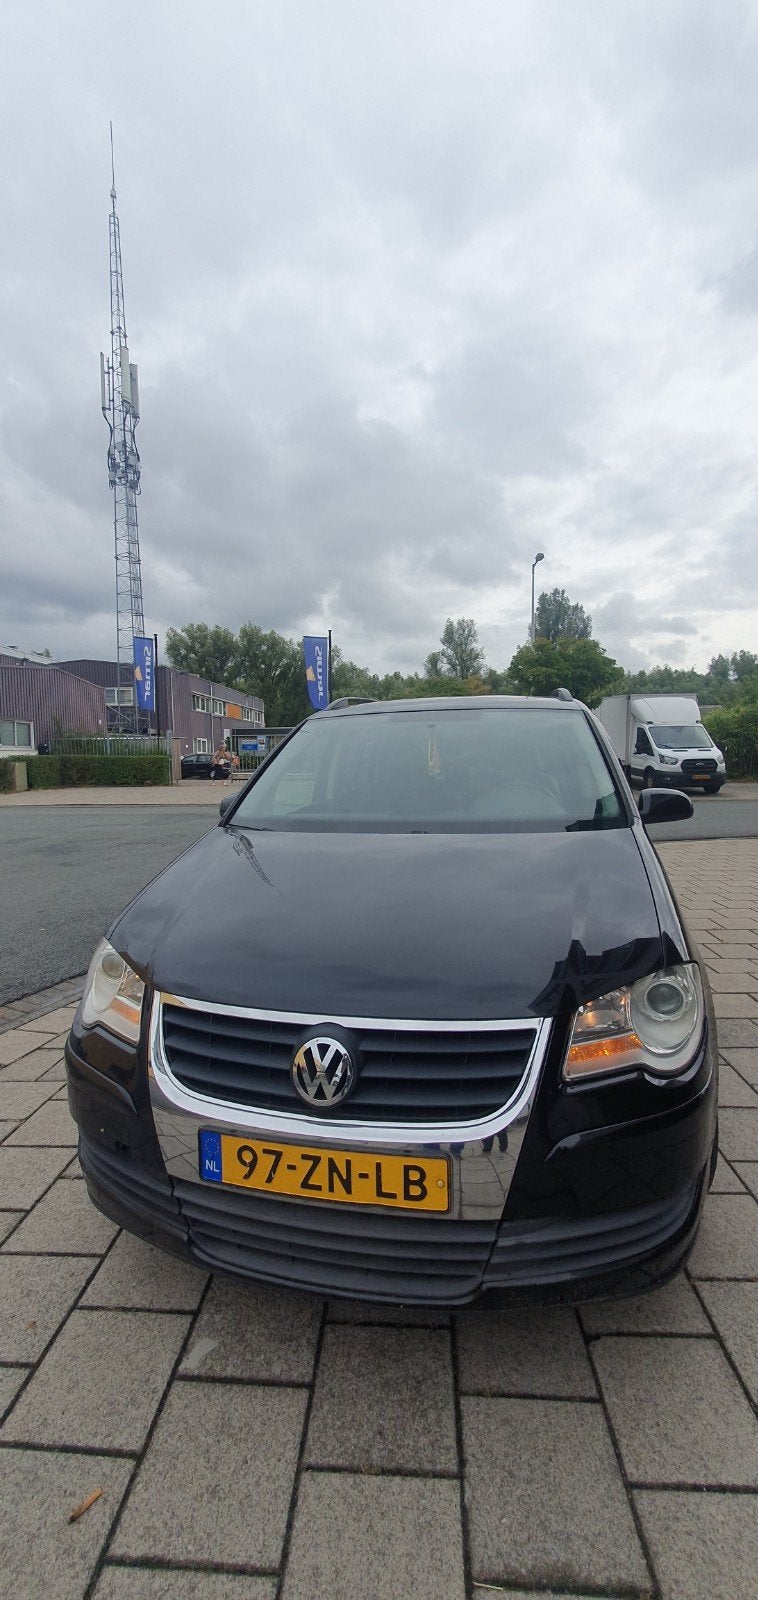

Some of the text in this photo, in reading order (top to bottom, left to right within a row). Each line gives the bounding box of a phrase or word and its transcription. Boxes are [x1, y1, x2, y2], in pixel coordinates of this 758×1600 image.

[293, 1037, 353, 1106] VW
[205, 1159, 219, 1173] NL
[236, 1144, 428, 1202] 97-ZN-LB
